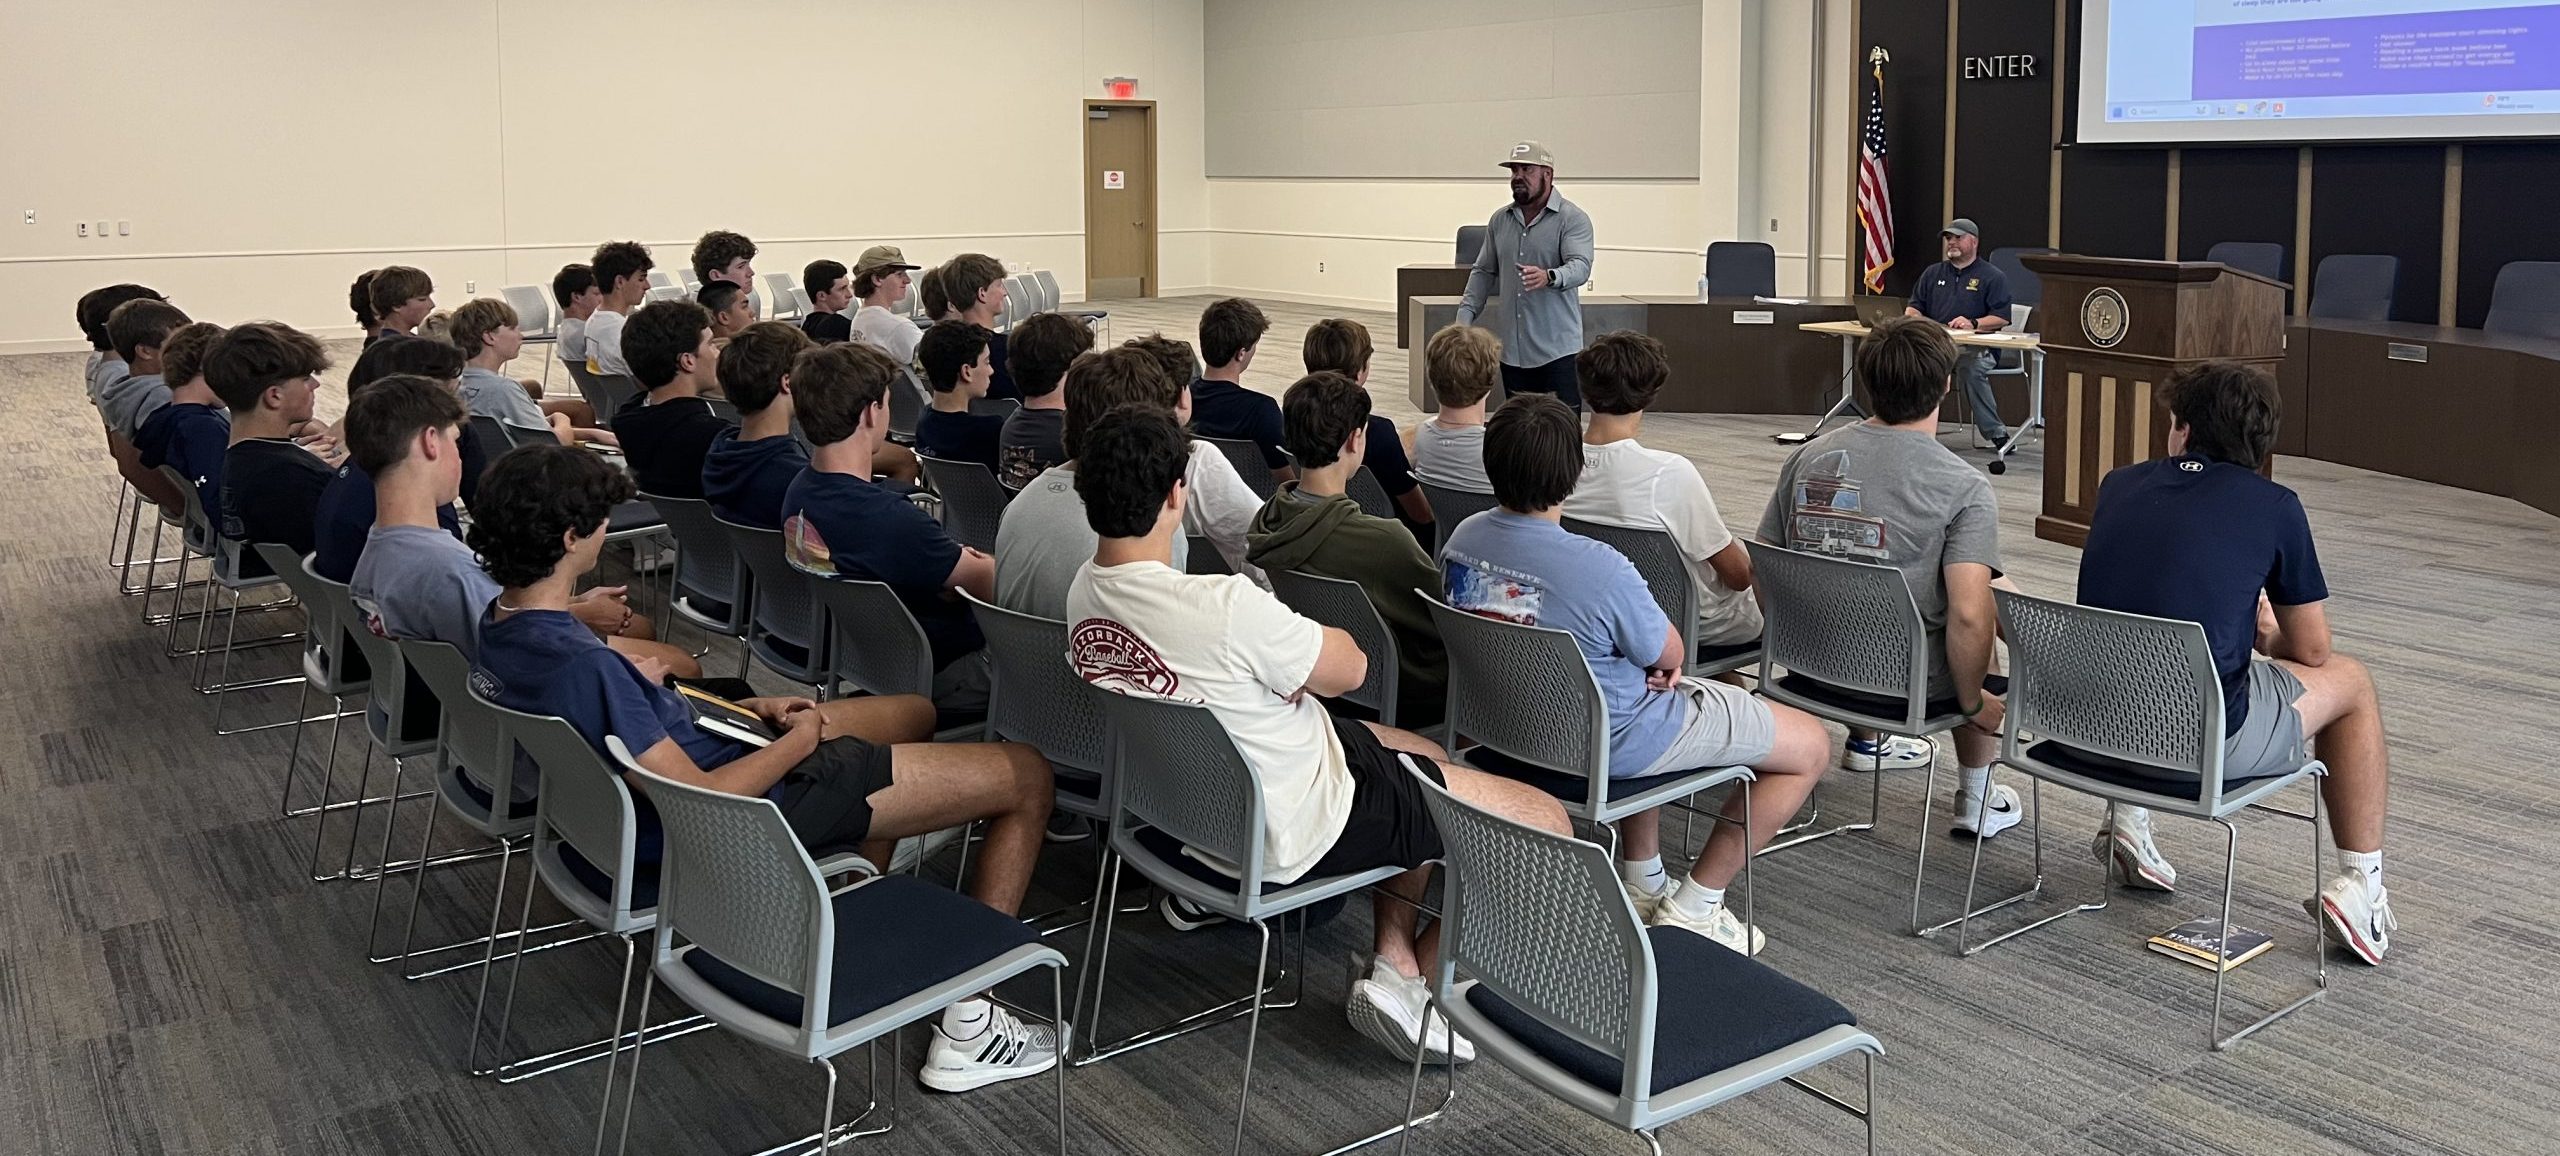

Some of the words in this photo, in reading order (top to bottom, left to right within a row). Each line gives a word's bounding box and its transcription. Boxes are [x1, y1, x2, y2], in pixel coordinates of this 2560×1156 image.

[1964, 54, 2034, 79] ENTER
[1511, 144, 1530, 158] P
[1084, 644, 1134, 667] Baseball
